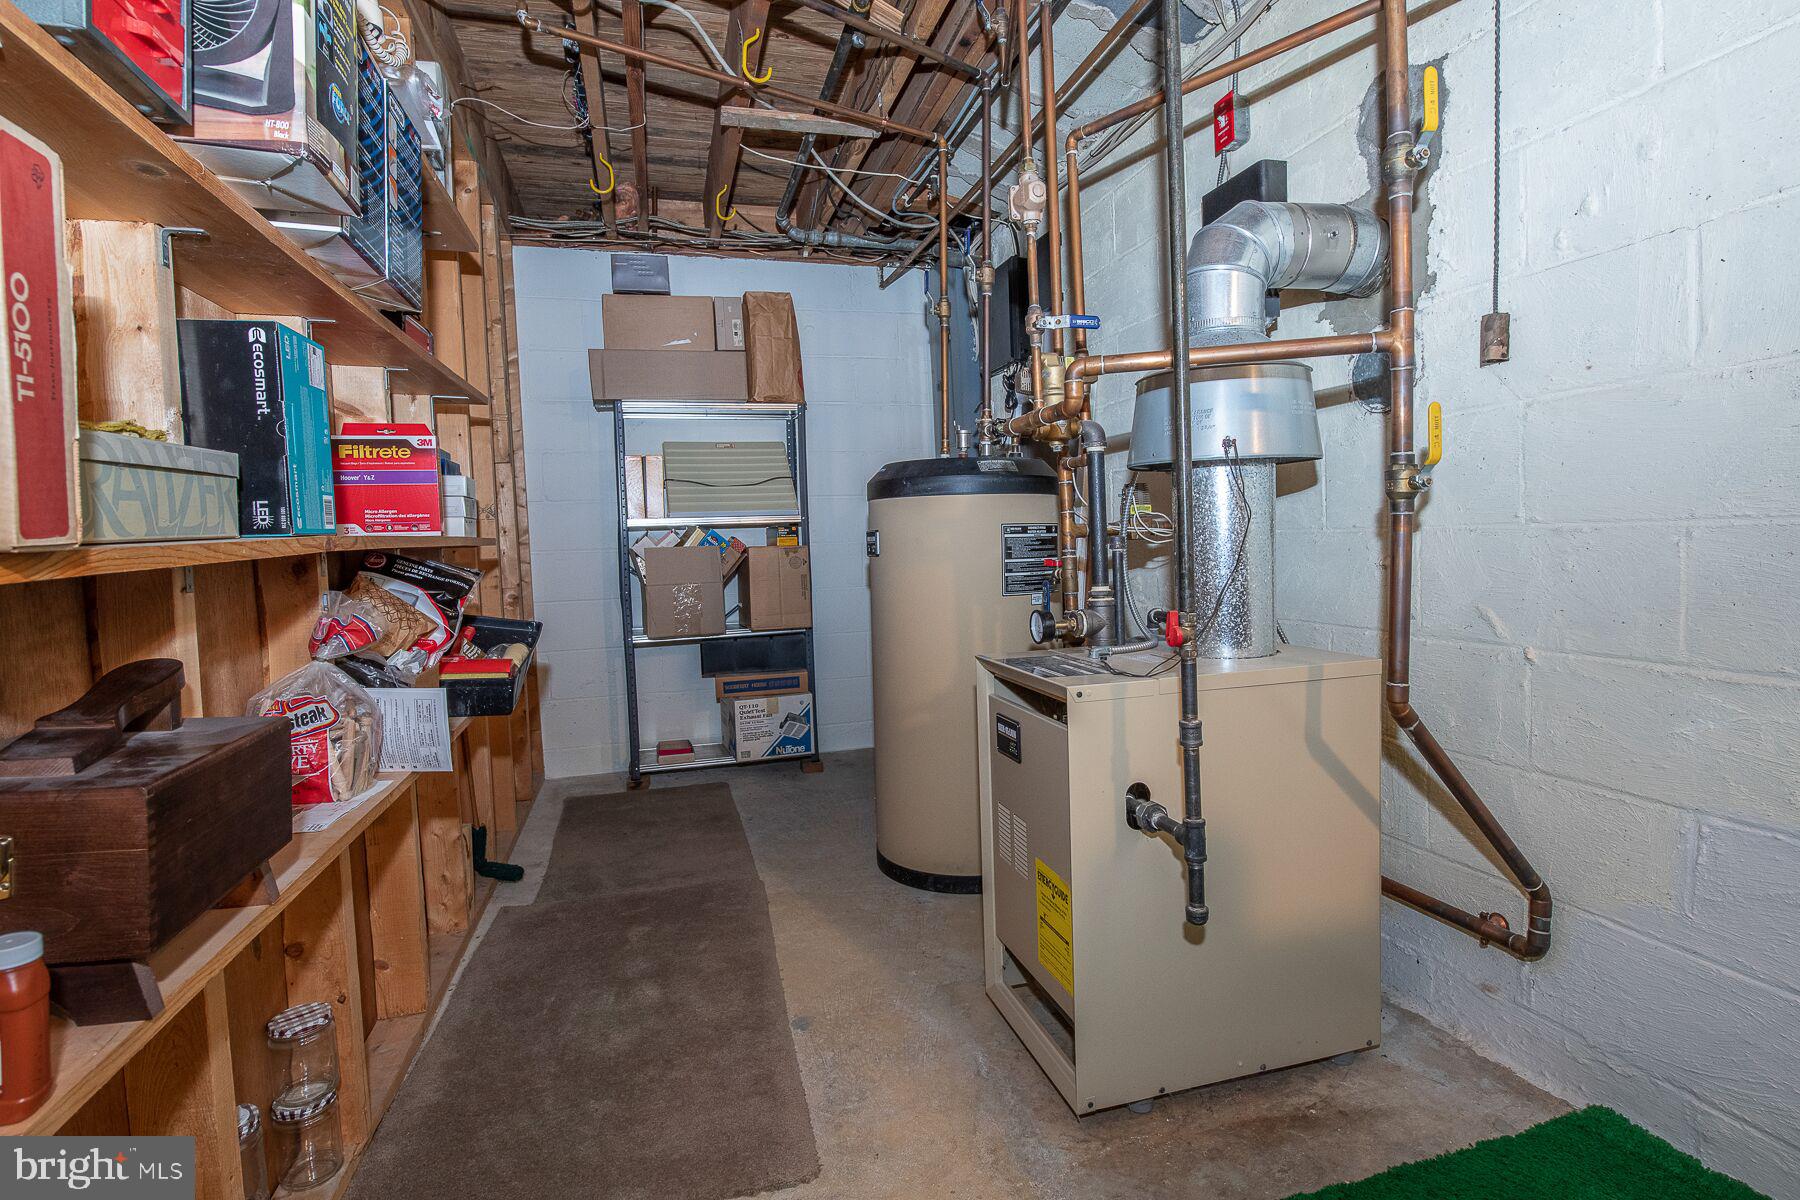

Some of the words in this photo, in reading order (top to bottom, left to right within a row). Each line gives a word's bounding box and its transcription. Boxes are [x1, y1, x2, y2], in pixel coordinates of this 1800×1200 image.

[10, 271, 36, 402] TI-5100
[416, 438, 433, 447] 3M
[338, 444, 412, 459] Filtrete
[256, 500, 269, 525] LED
[343, 526, 350, 535] 3
[775, 745, 806, 755] NuTone
